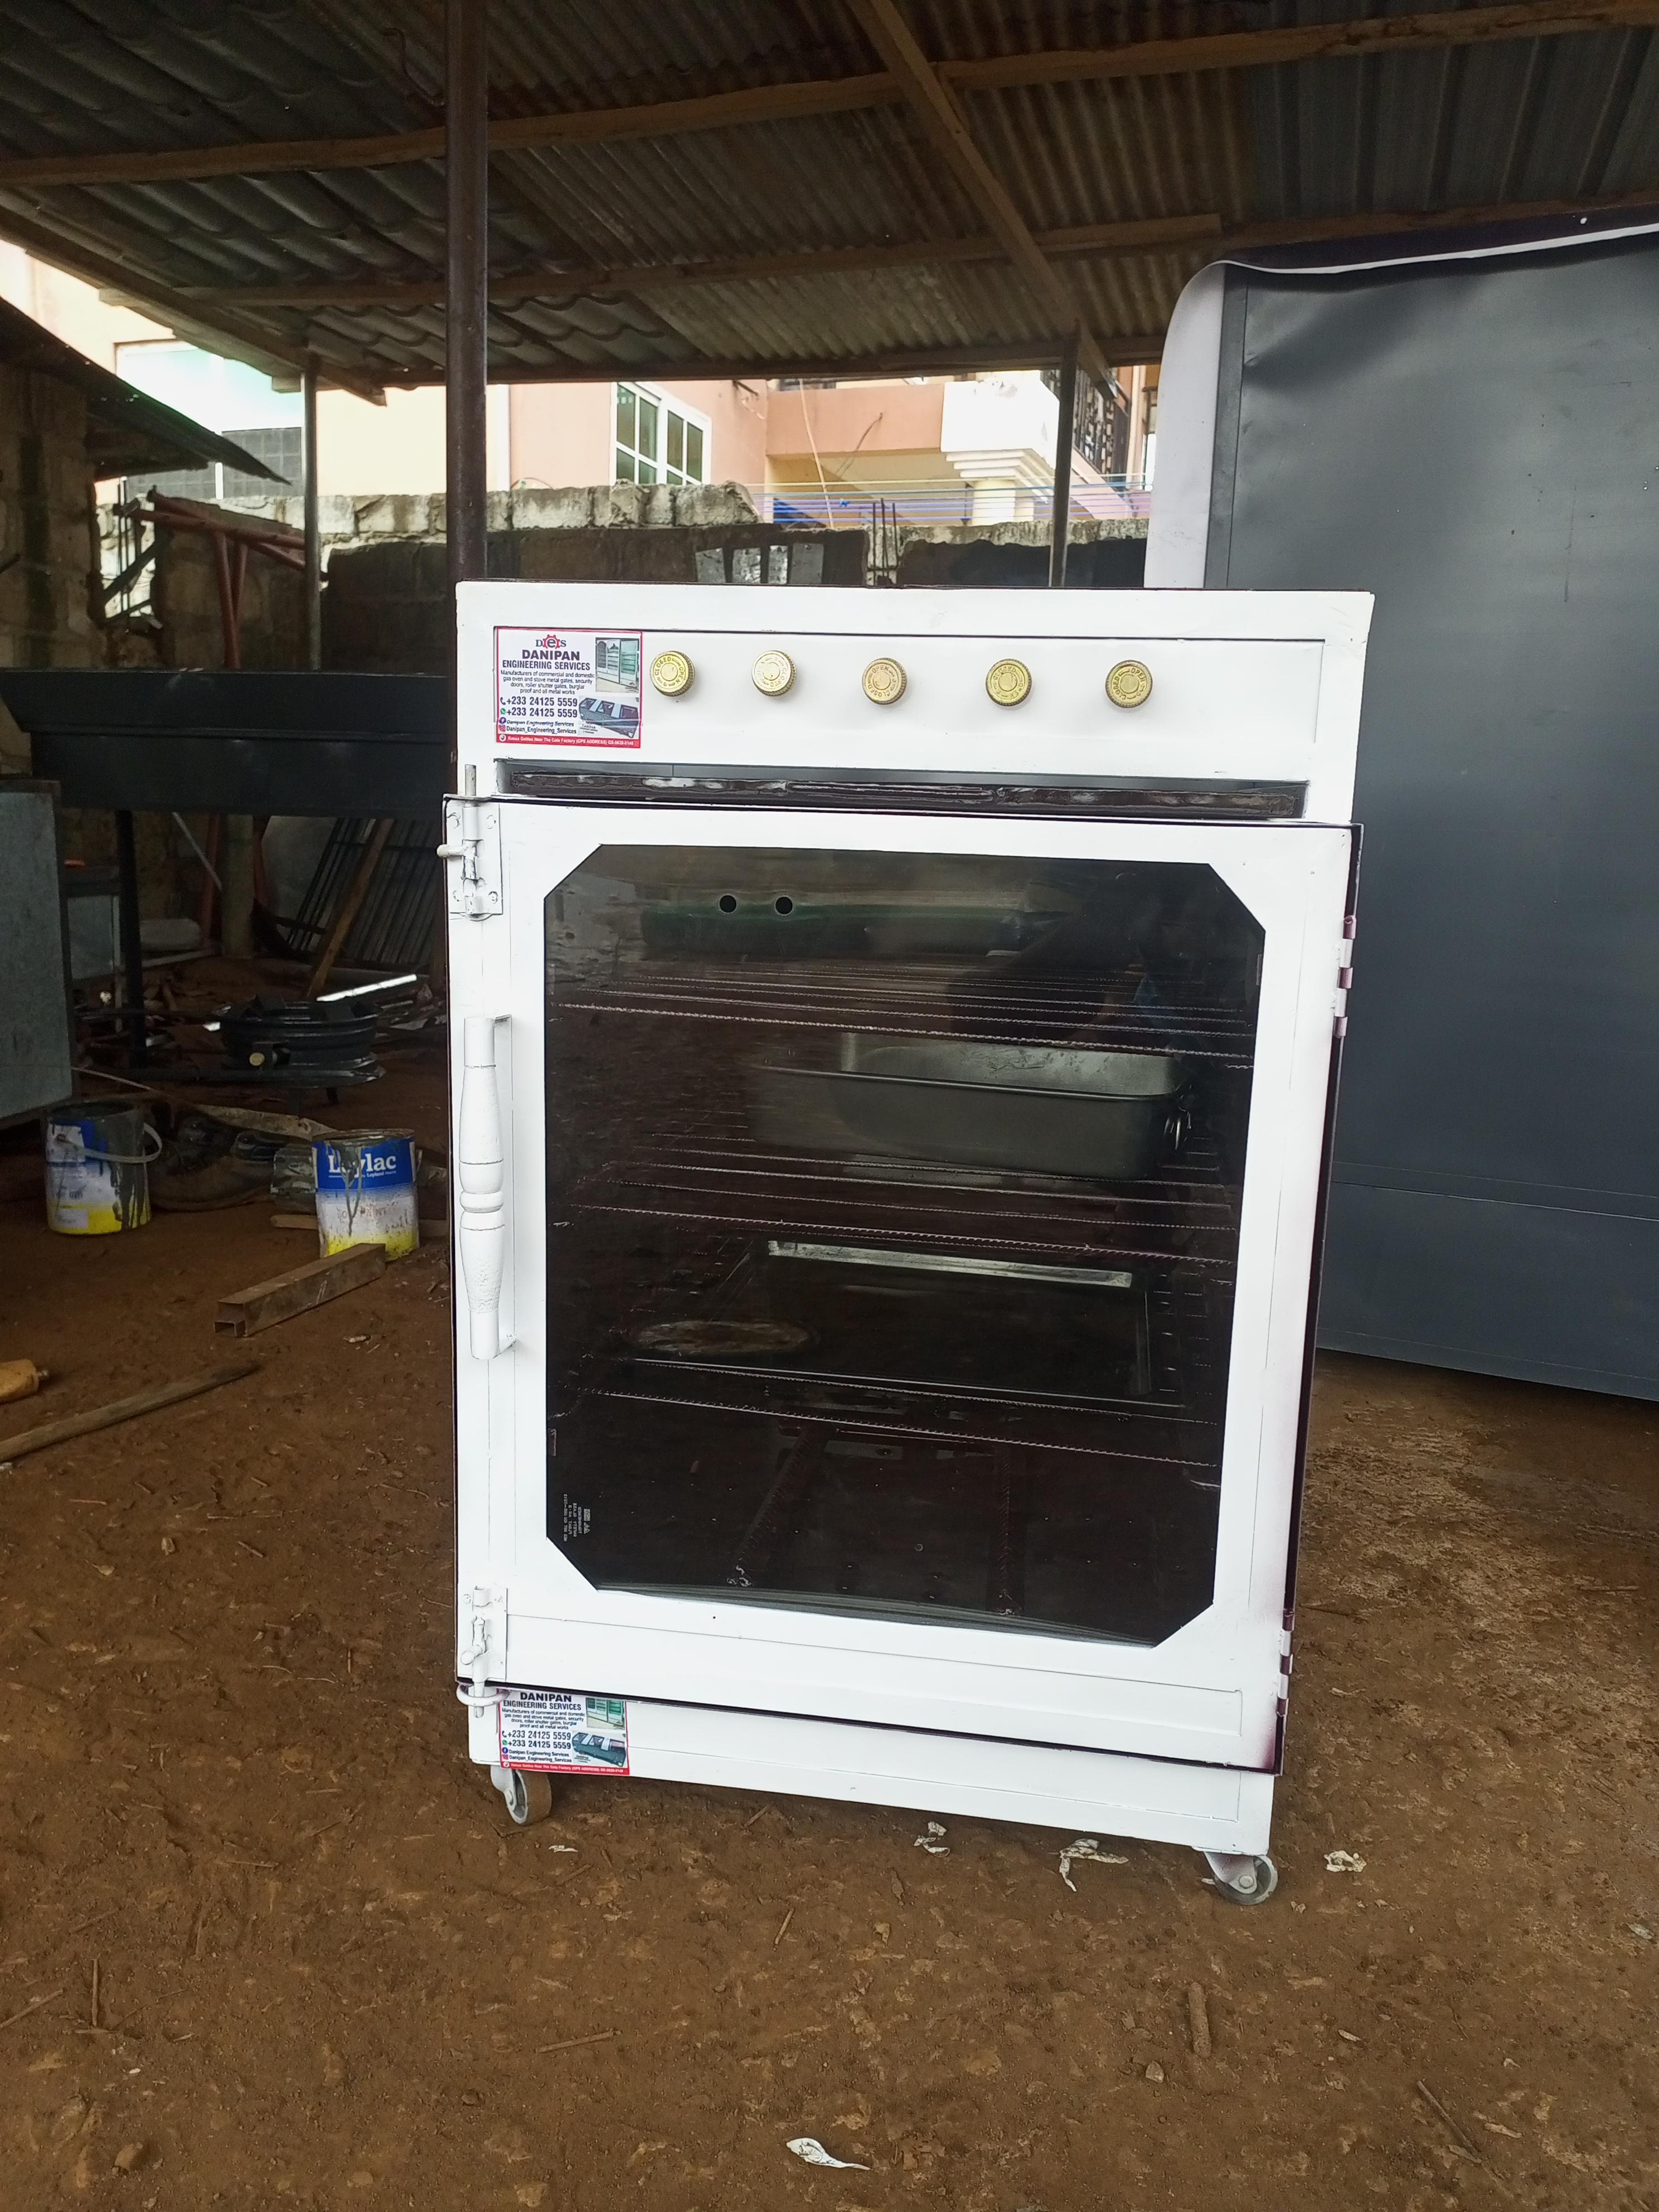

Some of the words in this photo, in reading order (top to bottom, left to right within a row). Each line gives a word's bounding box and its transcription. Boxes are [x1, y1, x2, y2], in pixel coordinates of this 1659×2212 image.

[522, 649, 580, 661] DANIPAN
[503, 660, 551, 669] ENGINEERING
[555, 662, 590, 670] SERVICES
[654, 657, 671, 676] CLOSED
[1131, 668, 1146, 682] OPEN
[868, 684, 890, 697] CLOSED
[1113, 676, 1126, 700] CLOSED
[507, 696, 526, 705] +233
[530, 697, 554, 706] 24125
[557, 698, 578, 706] 5559
[507, 707, 526, 716] +233
[530, 708, 554, 717] 24125
[557, 709, 578, 717] 5559
[520, 1692, 571, 1702] DANIPAN
[503, 1700, 547, 1709] ENGINEERING
[553, 1732, 571, 1740] 5559
